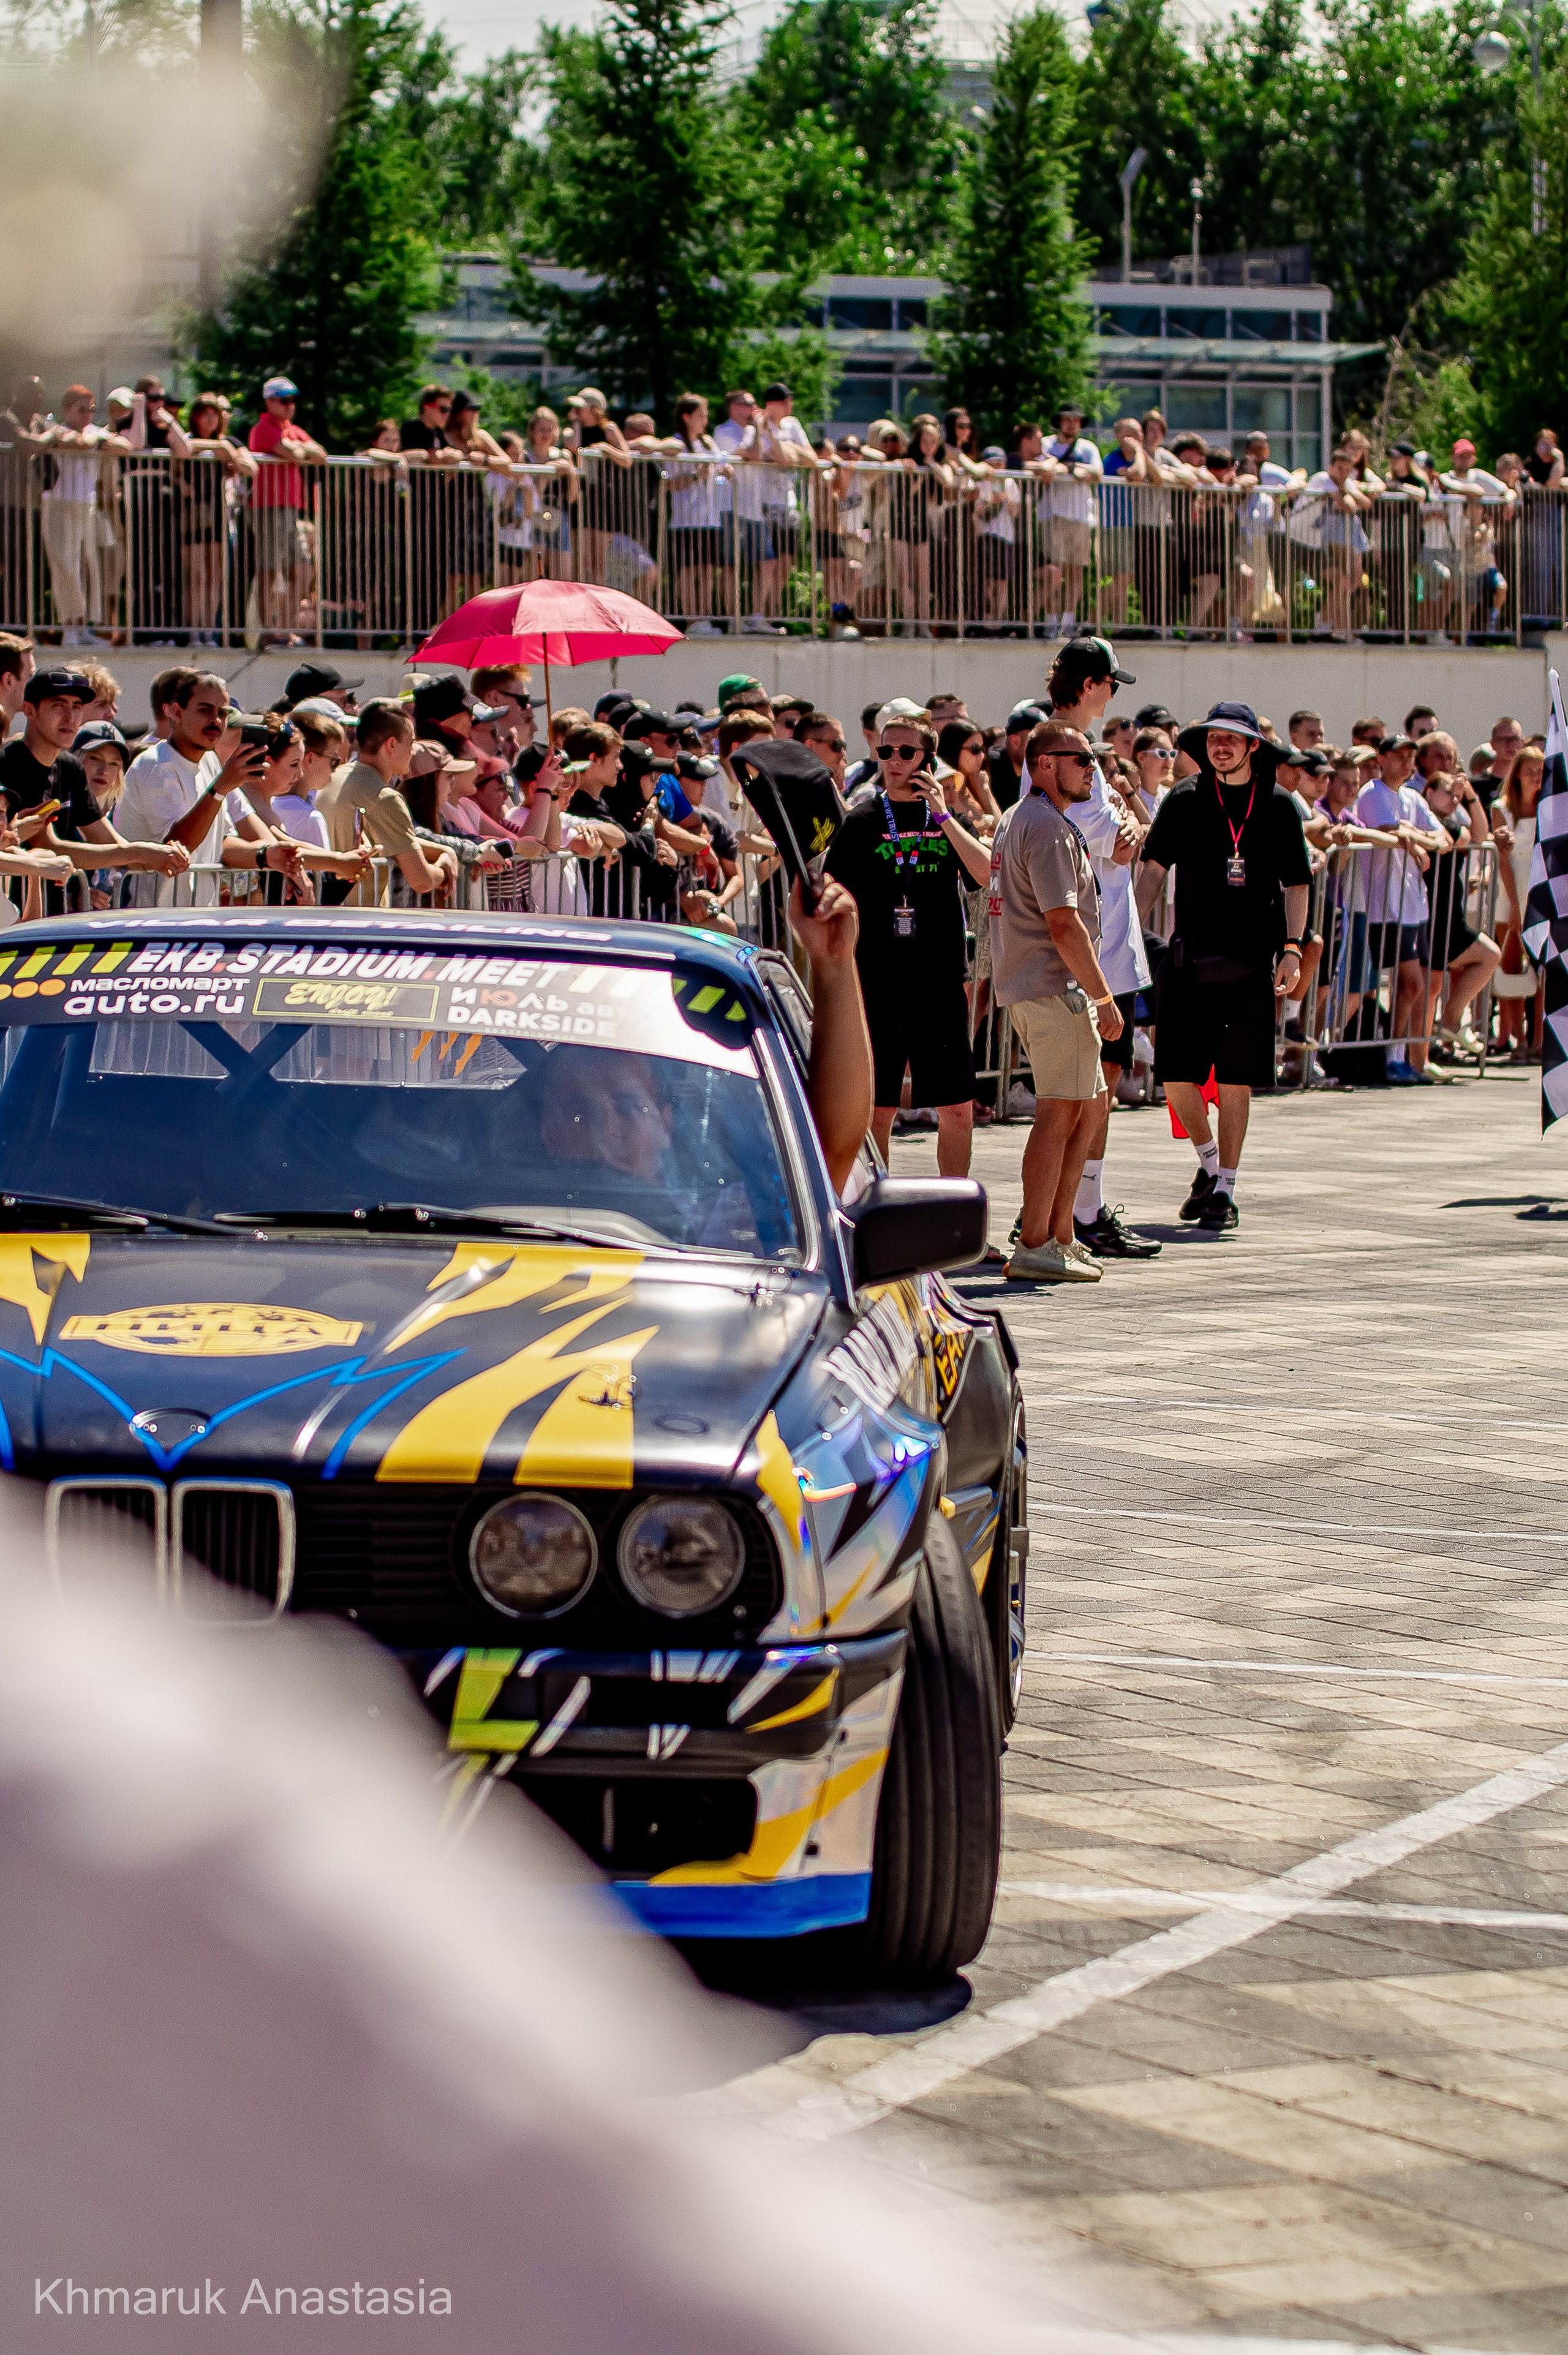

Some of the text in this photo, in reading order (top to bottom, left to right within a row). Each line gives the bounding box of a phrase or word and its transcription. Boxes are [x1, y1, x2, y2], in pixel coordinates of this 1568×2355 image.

[888, 819, 900, 842] TRUST
[70, 976, 250, 993] масломарт
[64, 990, 246, 1016] auto.ru
[447, 1005, 618, 1038] DARKSIDE
